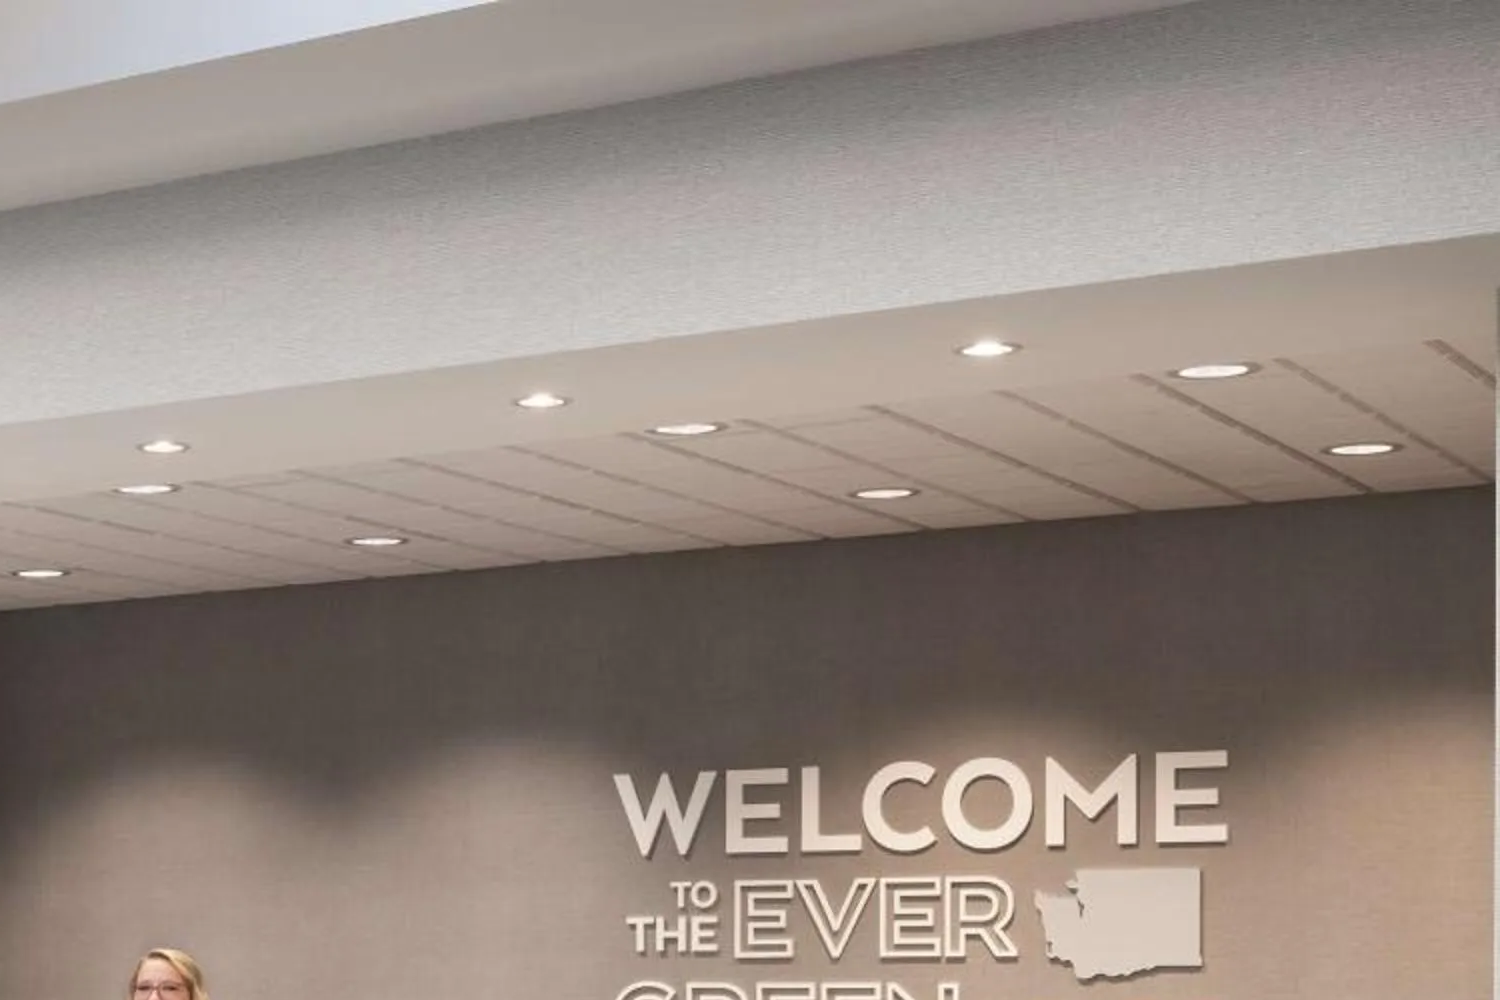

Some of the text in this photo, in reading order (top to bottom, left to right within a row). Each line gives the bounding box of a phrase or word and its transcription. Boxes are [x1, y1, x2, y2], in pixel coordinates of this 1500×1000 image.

[612, 749, 1229, 858] WELCOME
[669, 880, 718, 909] TO
[733, 875, 1018, 960] EVER
[626, 915, 719, 955] THE
